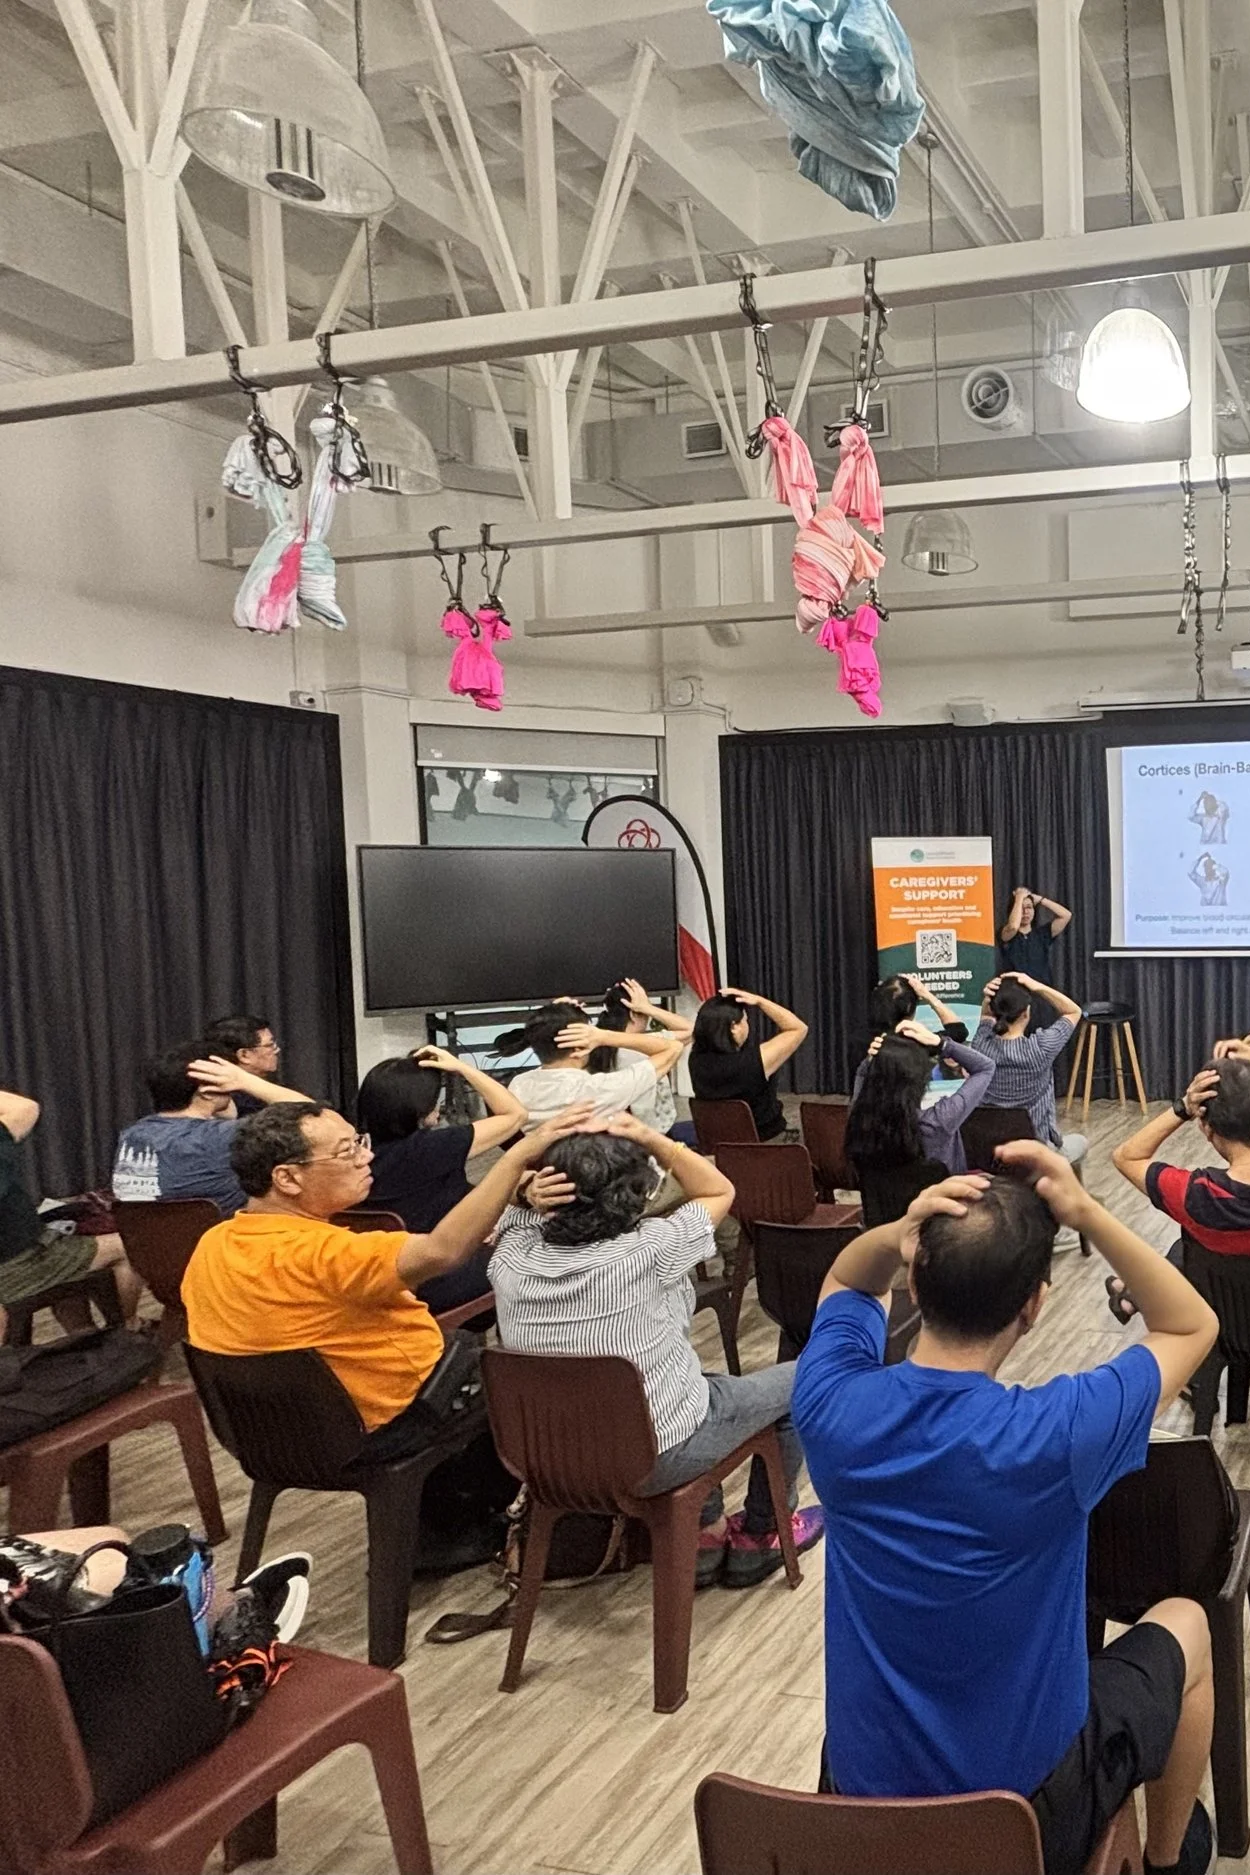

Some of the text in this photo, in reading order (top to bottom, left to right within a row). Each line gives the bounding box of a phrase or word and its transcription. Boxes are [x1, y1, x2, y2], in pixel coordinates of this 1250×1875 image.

[1138, 764, 1191, 777] Cortices
[903, 889, 966, 901] SUPPORT
[924, 981, 960, 991] EEDED
